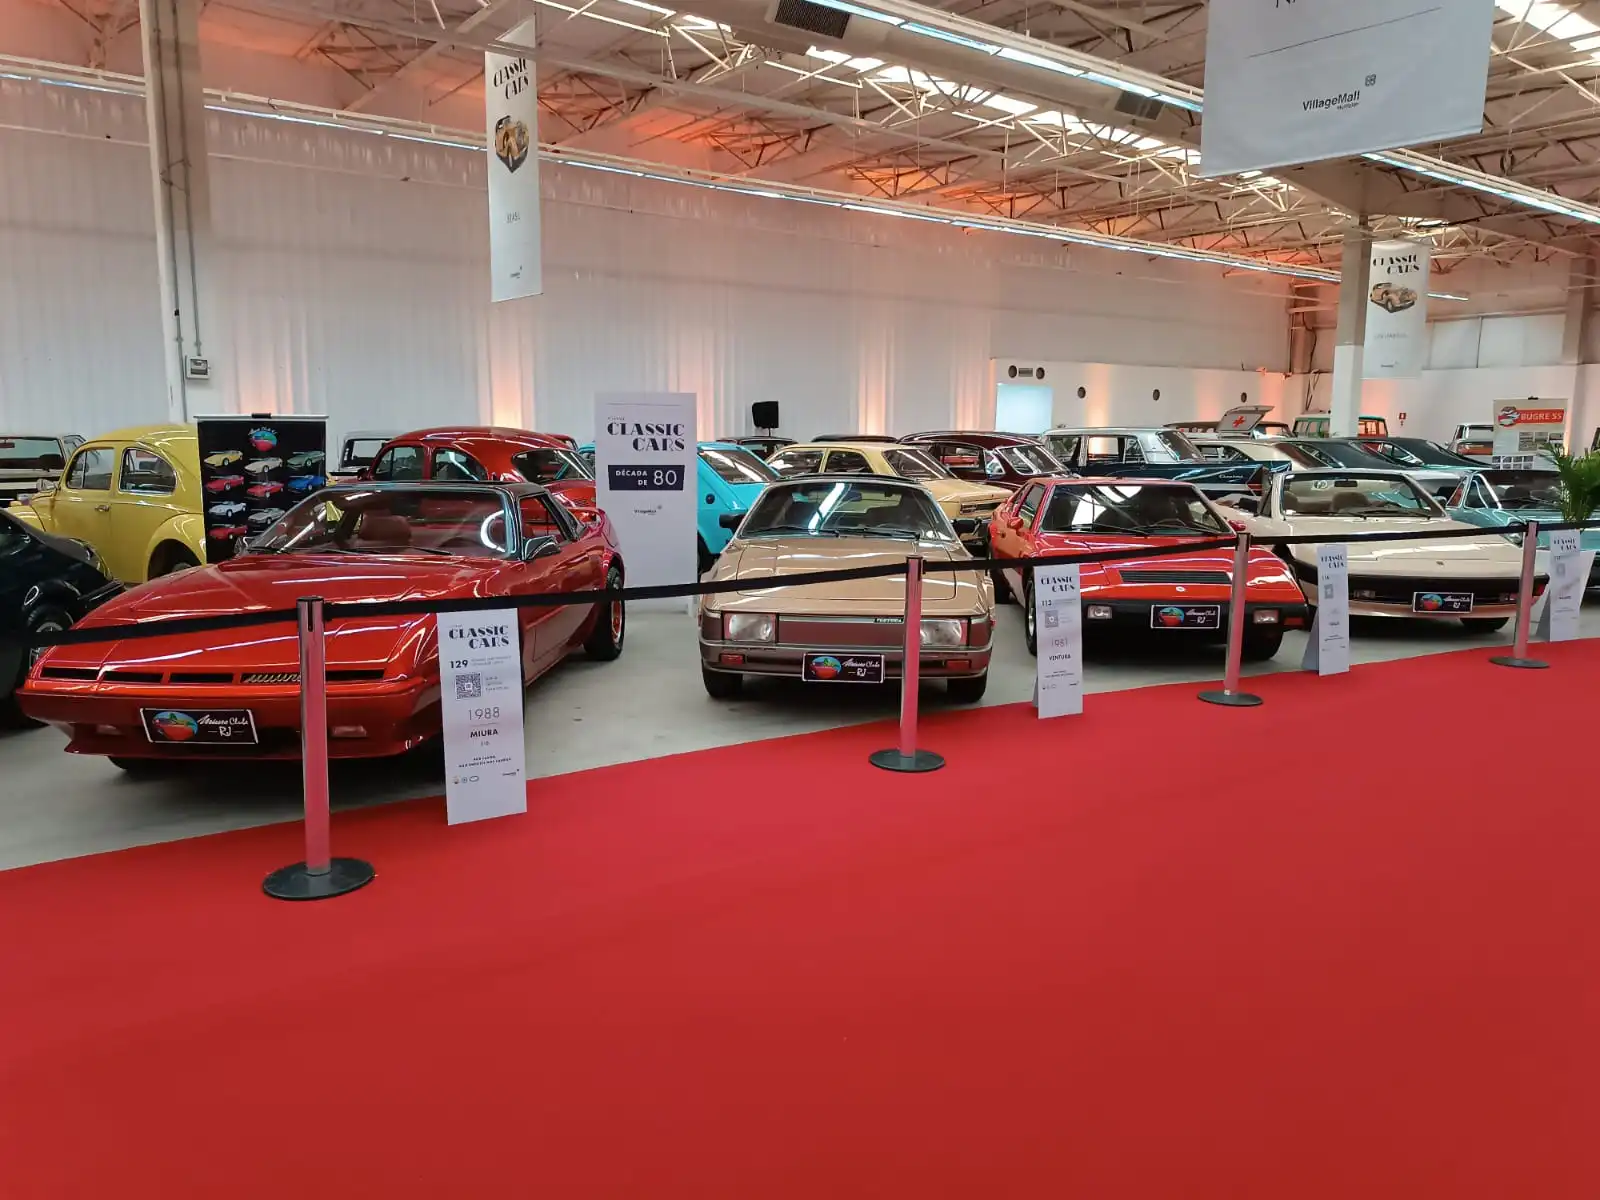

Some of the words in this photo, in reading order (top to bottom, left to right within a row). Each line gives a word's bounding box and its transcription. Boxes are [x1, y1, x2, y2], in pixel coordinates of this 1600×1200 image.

[505, 75, 529, 100] CARS
[1302, 90, 1360, 111] VillageMall
[1373, 254, 1417, 267] CLASSIC
[1387, 264, 1420, 275] CARS
[1520, 413, 1550, 421] BUGRE
[607, 422, 685, 436] CLASSIC
[632, 437, 685, 452] CARS
[615, 468, 648, 477] DÉCADA
[653, 470, 677, 486] 80
[1041, 576, 1073, 585] CLASSIC
[1052, 584, 1075, 593] CARS
[448, 625, 509, 640] CLASSIC
[468, 637, 509, 650] CARS
[450, 660, 469, 669] 129
[469, 707, 500, 720] 1988
[219, 726, 232, 737] RJ
[470, 729, 499, 738] MIURA
